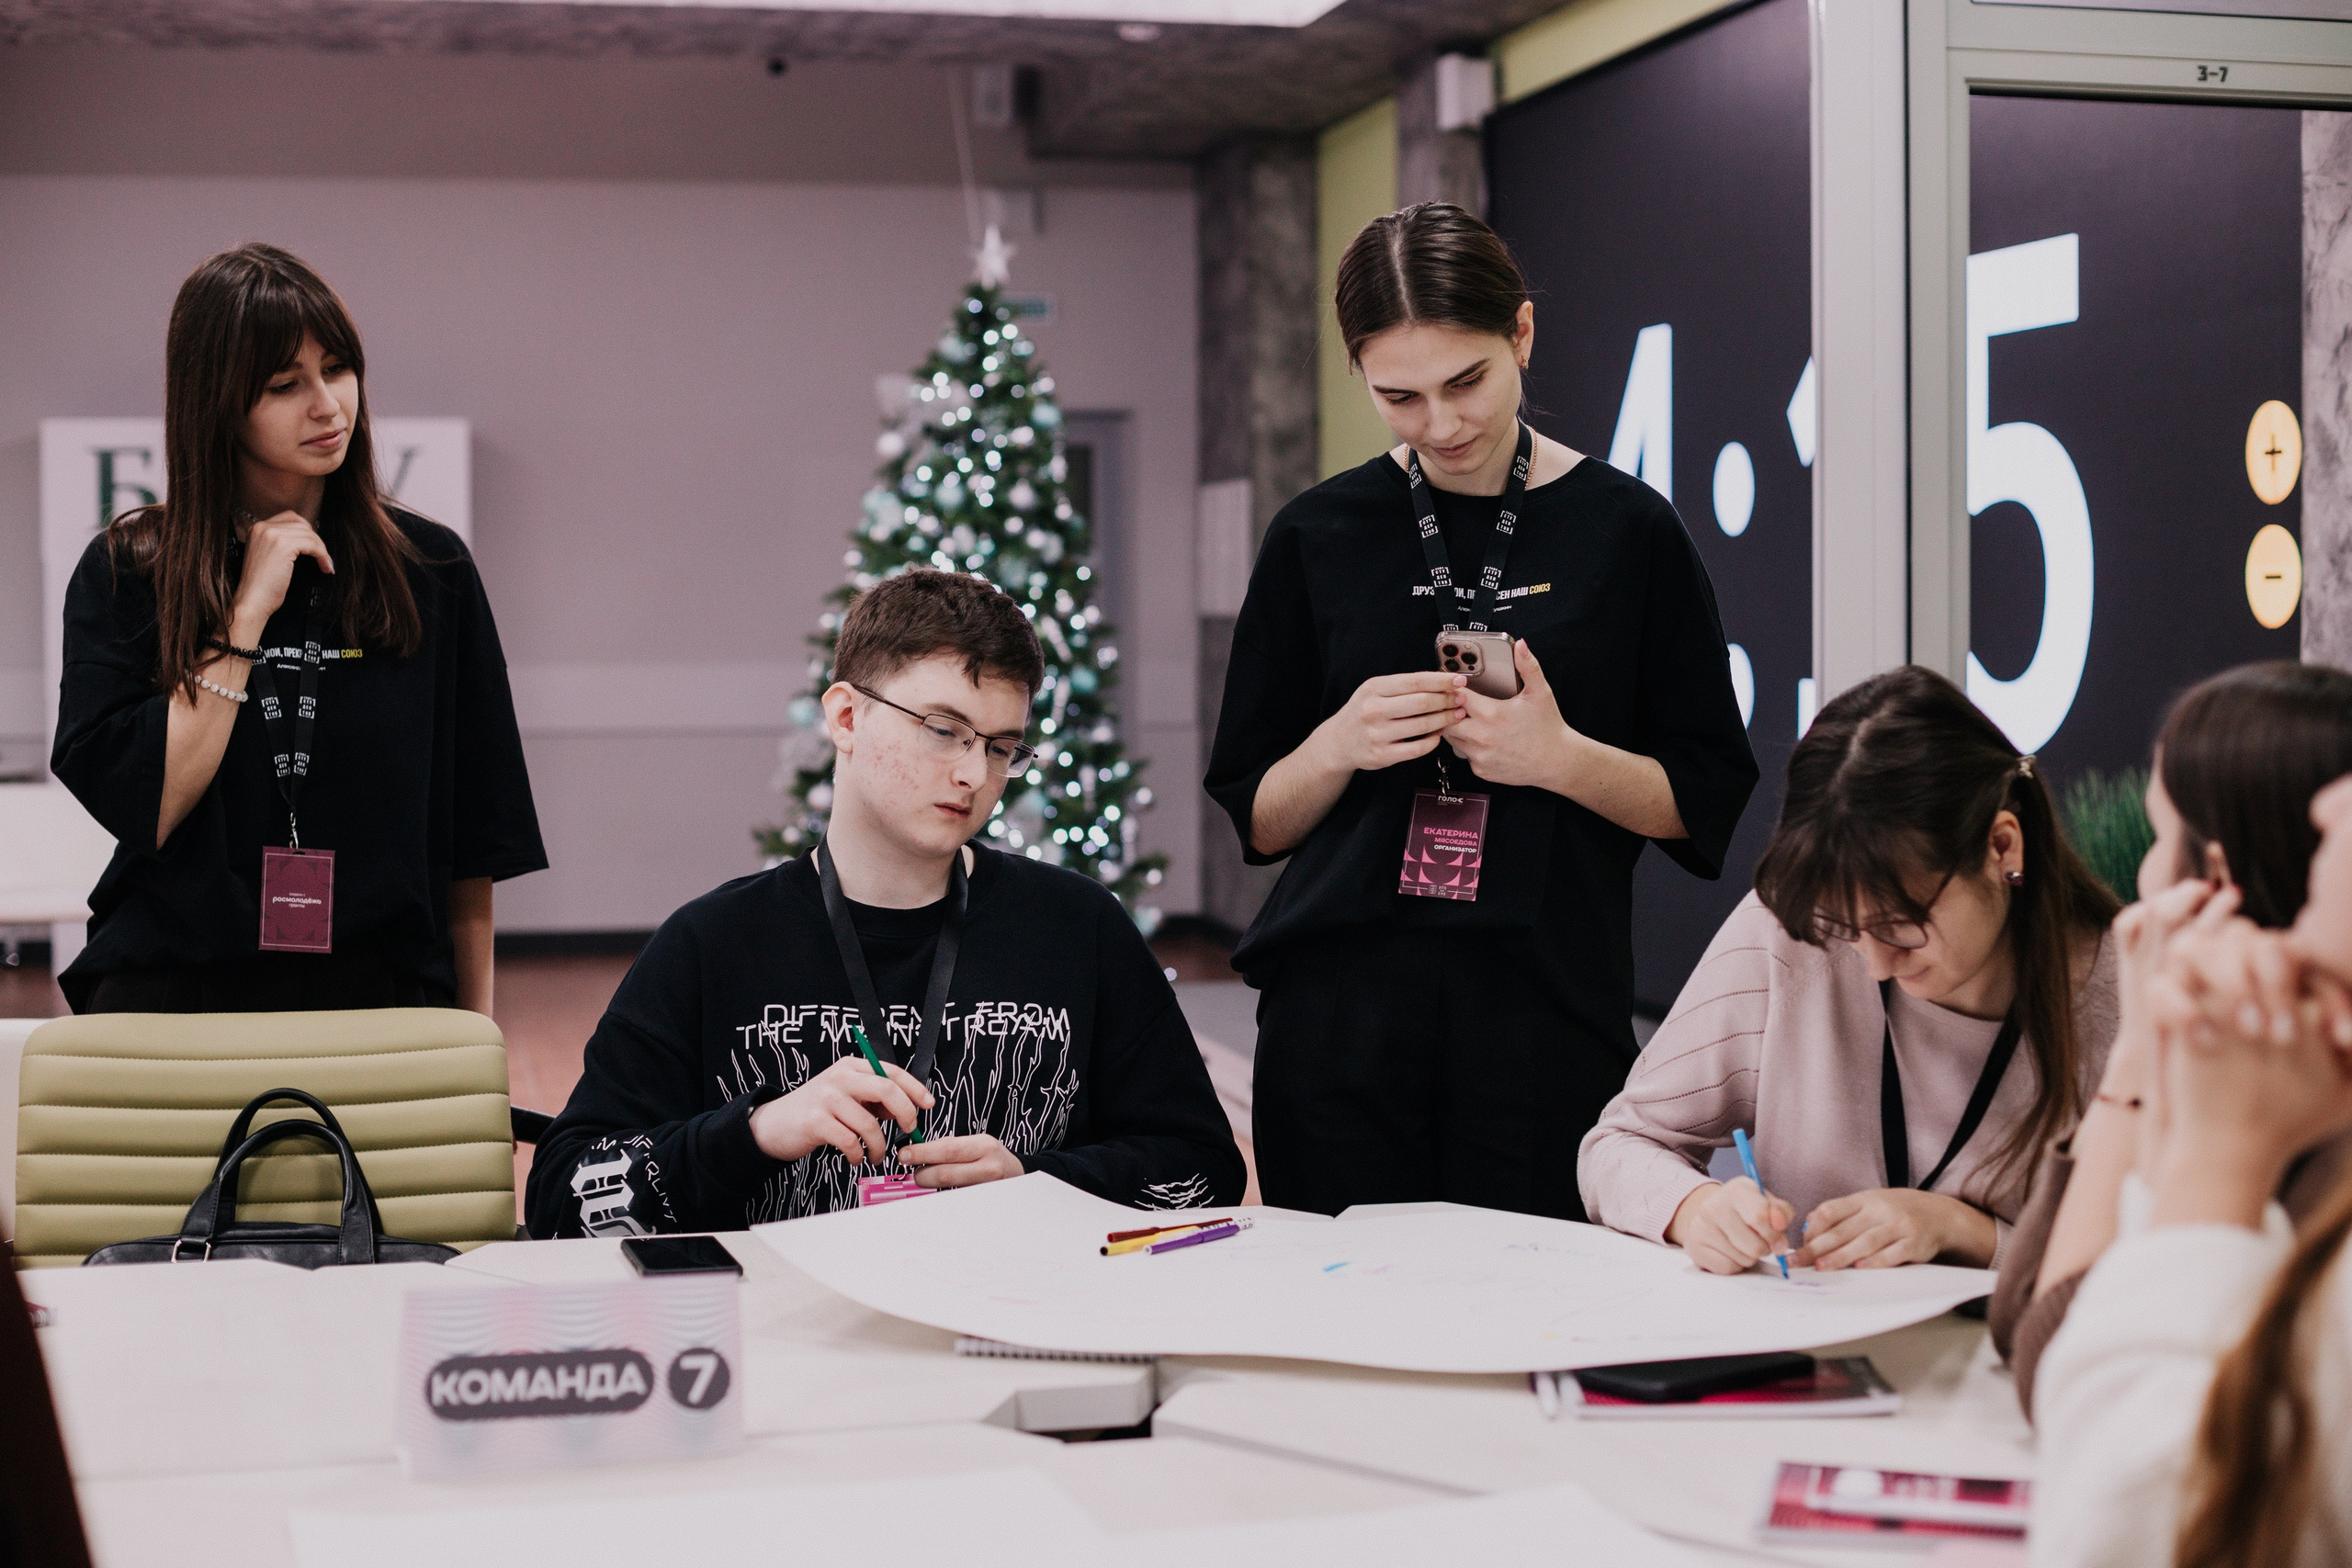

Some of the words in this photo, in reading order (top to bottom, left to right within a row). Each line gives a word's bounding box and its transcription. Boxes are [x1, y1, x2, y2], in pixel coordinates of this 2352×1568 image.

[2198, 65, 2228, 82] 3-7
[1412, 586, 1435, 596] ДРУЗ
[1511, 587, 1528, 598] НАШ
[1529, 583, 1551, 594] СОЮЗ
[322, 649, 340, 660] НАШ
[341, 649, 363, 658] СОЮЗ
[1423, 827, 1478, 839] ЕКАТЕРИНА
[1434, 838, 1477, 846] МЯСОЕДОВА
[1434, 844, 1476, 853] ОРГАНИЗАТОР
[431, 1362, 647, 1406] КОМАНДА
[679, 1354, 718, 1404] 7
